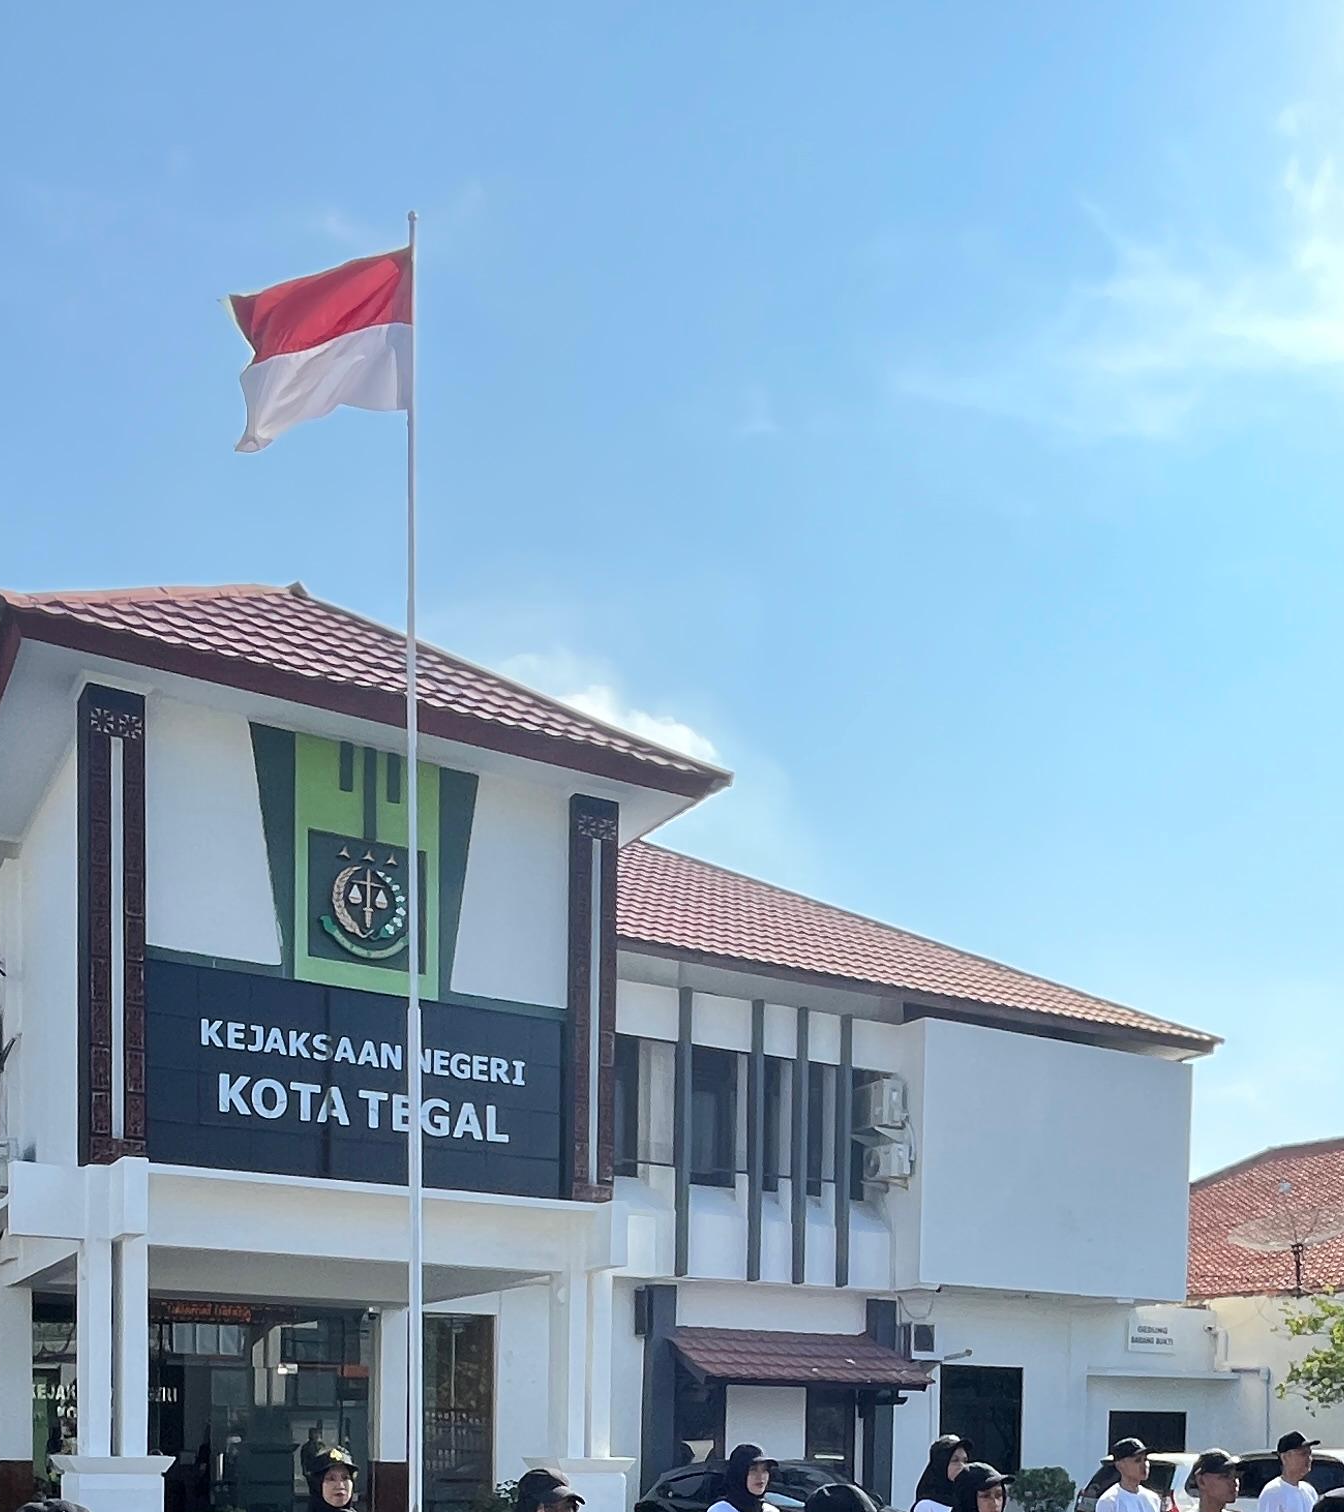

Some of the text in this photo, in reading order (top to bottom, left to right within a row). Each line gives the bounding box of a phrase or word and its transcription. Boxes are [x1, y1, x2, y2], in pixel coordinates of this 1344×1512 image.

[200, 1018, 526, 1087] KEJAKSAAN NEGERI
[218, 1072, 510, 1144] KOTA TEGAL
